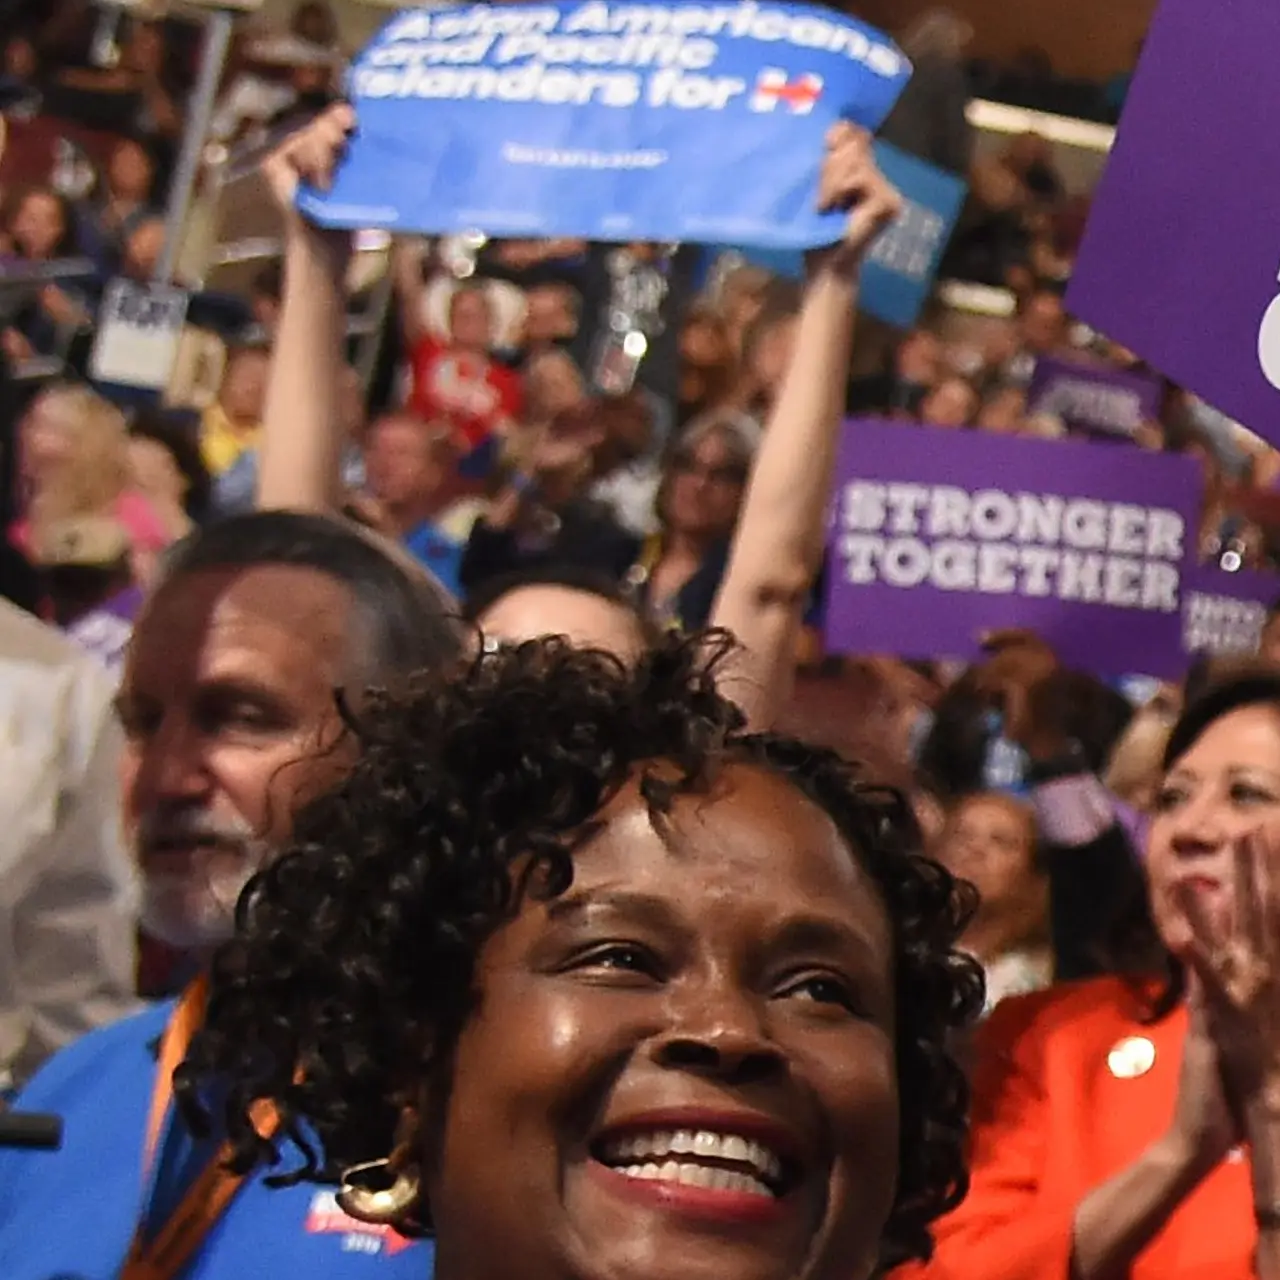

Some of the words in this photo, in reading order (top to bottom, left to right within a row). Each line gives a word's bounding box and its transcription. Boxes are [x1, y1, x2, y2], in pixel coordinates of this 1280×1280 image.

[370, 31, 496, 67] and
[496, 31, 719, 70] Pacific
[382, 2, 561, 41] Asian
[563, 0, 904, 79] Americans
[644, 67, 747, 110] for
[843, 478, 1185, 561] STRONGER
[841, 533, 1181, 614] TOGETHER
